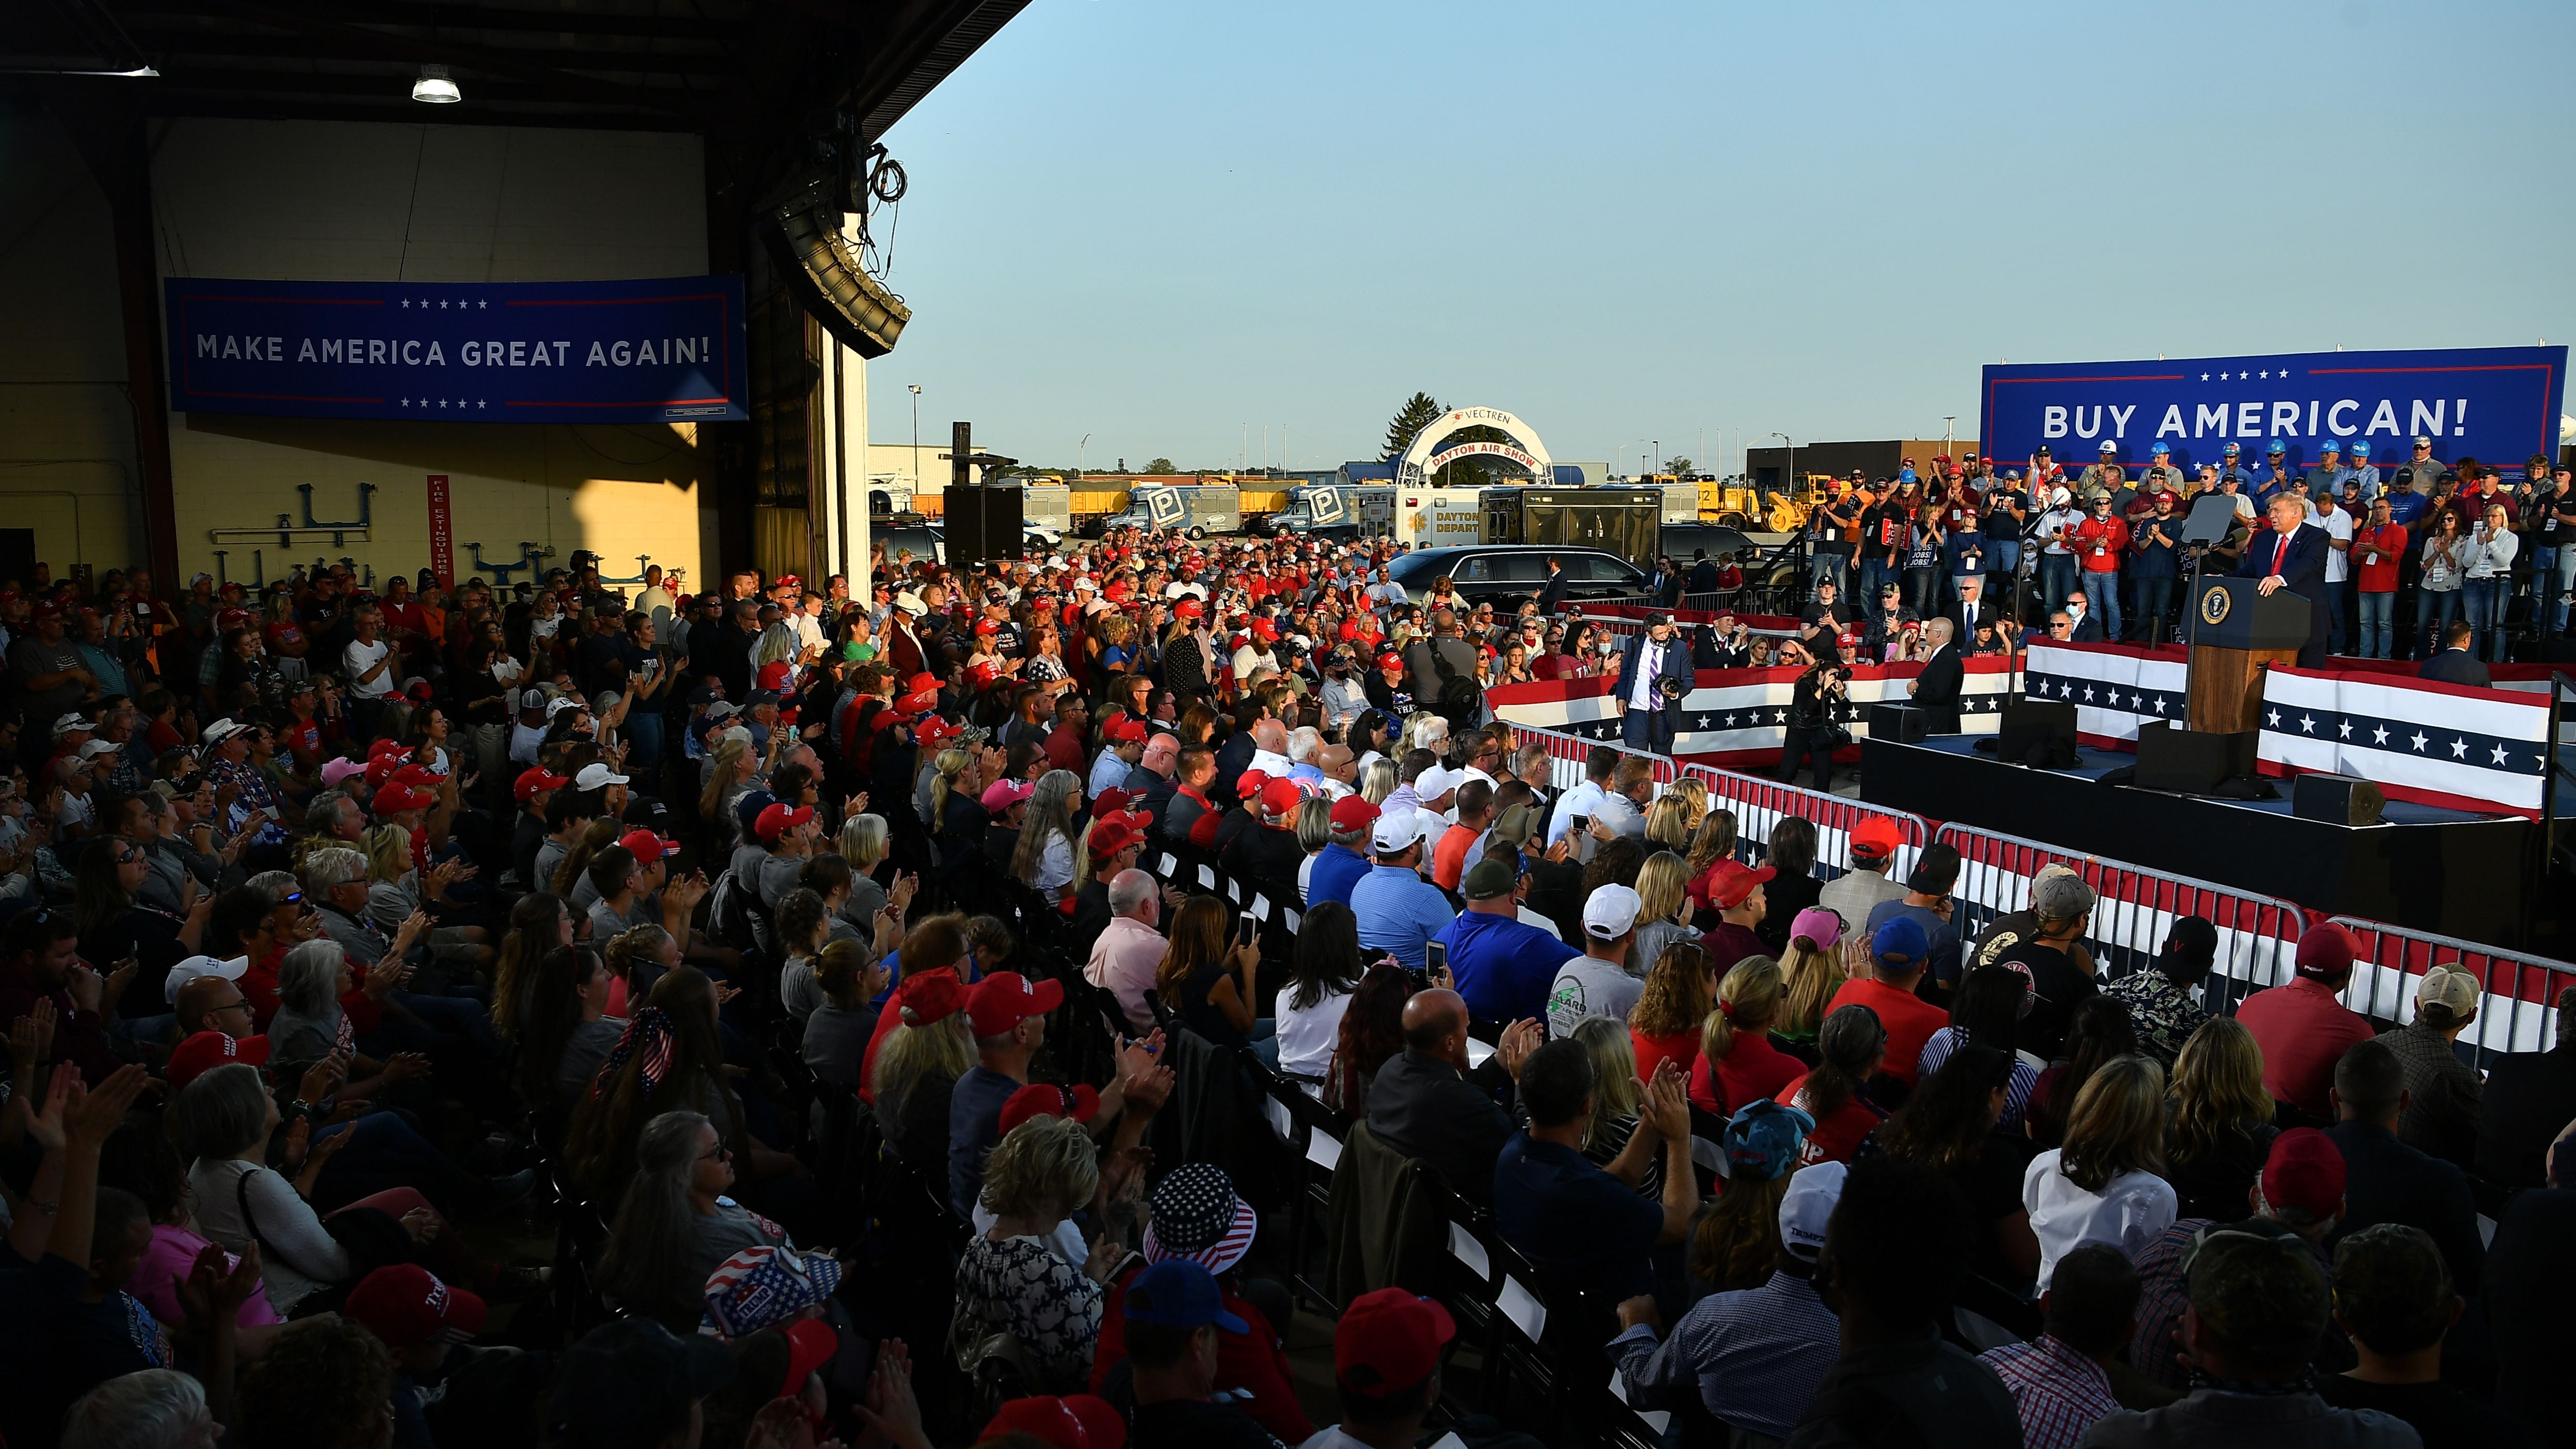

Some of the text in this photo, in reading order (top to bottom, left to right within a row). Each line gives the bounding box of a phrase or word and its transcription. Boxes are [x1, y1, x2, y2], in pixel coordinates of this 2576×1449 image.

[198, 335, 708, 366] MAKE AMERICA GREAT AGAIN!
[1465, 409, 1510, 424] VECTREN
[2044, 399, 2467, 439] BUY AMERICAN!
[1432, 444, 1536, 468] DAYTON AIR SHOW
[1437, 512, 1478, 521] DAYTON
[433, 480, 448, 575] FIRE EXTINGUISHER
[1437, 524, 1478, 533] DEPART
[2182, 559, 2197, 571] JOB
[933, 727, 943, 738] 45
[381, 768, 390, 778] 45
[1411, 831, 1416, 840] 45
[741, 1287, 771, 1317] TRUMP
